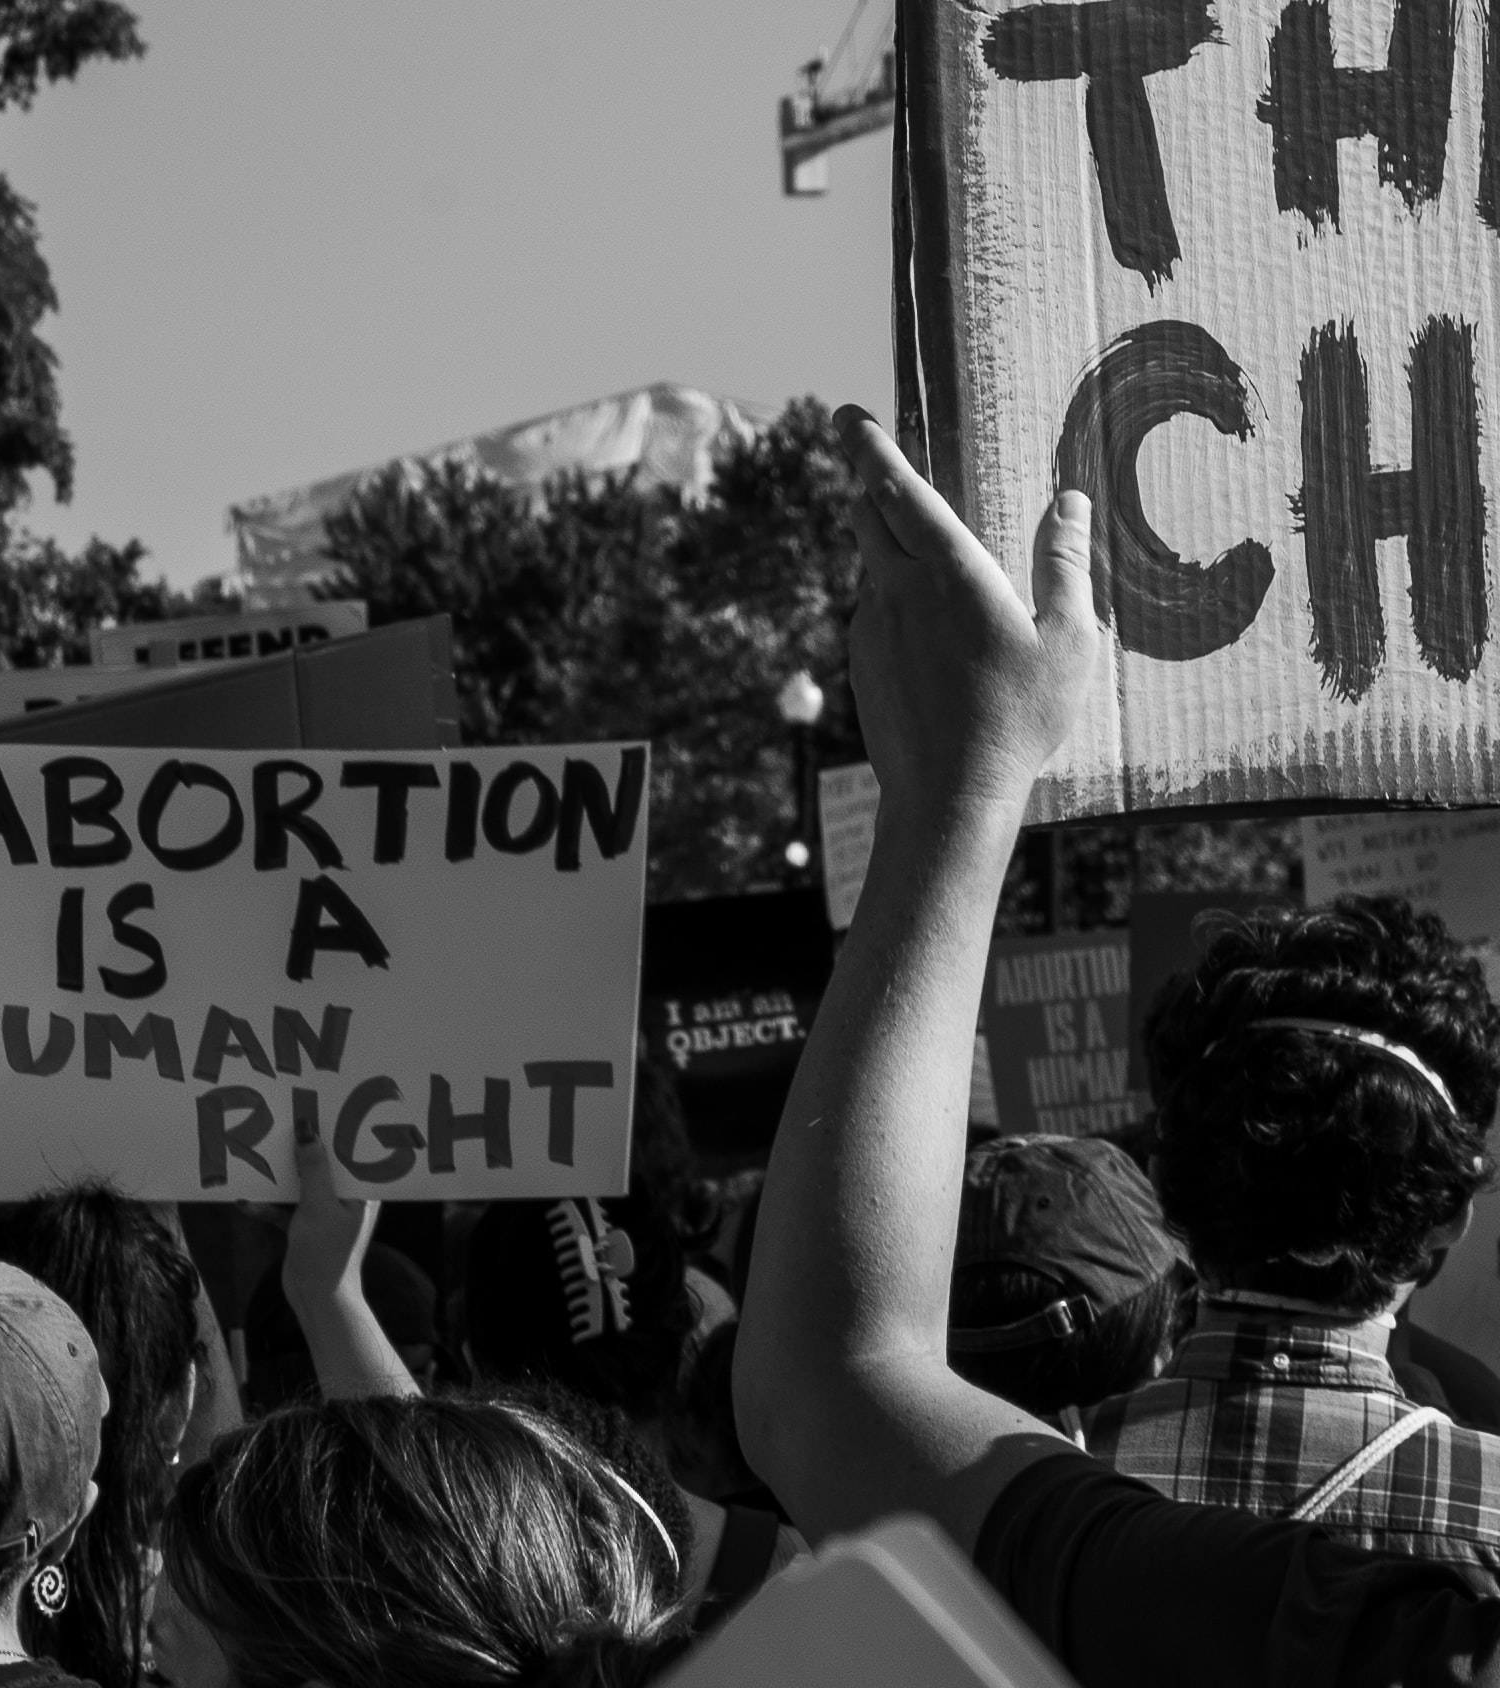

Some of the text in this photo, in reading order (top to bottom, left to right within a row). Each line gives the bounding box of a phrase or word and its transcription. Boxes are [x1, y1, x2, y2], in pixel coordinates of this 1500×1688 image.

[55, 874, 391, 999] IS A
[663, 1000, 683, 1026] I
[692, 998, 743, 1023] am
[666, 1014, 806, 1056] OBJECT.
[194, 1060, 613, 1188] RIGHT
